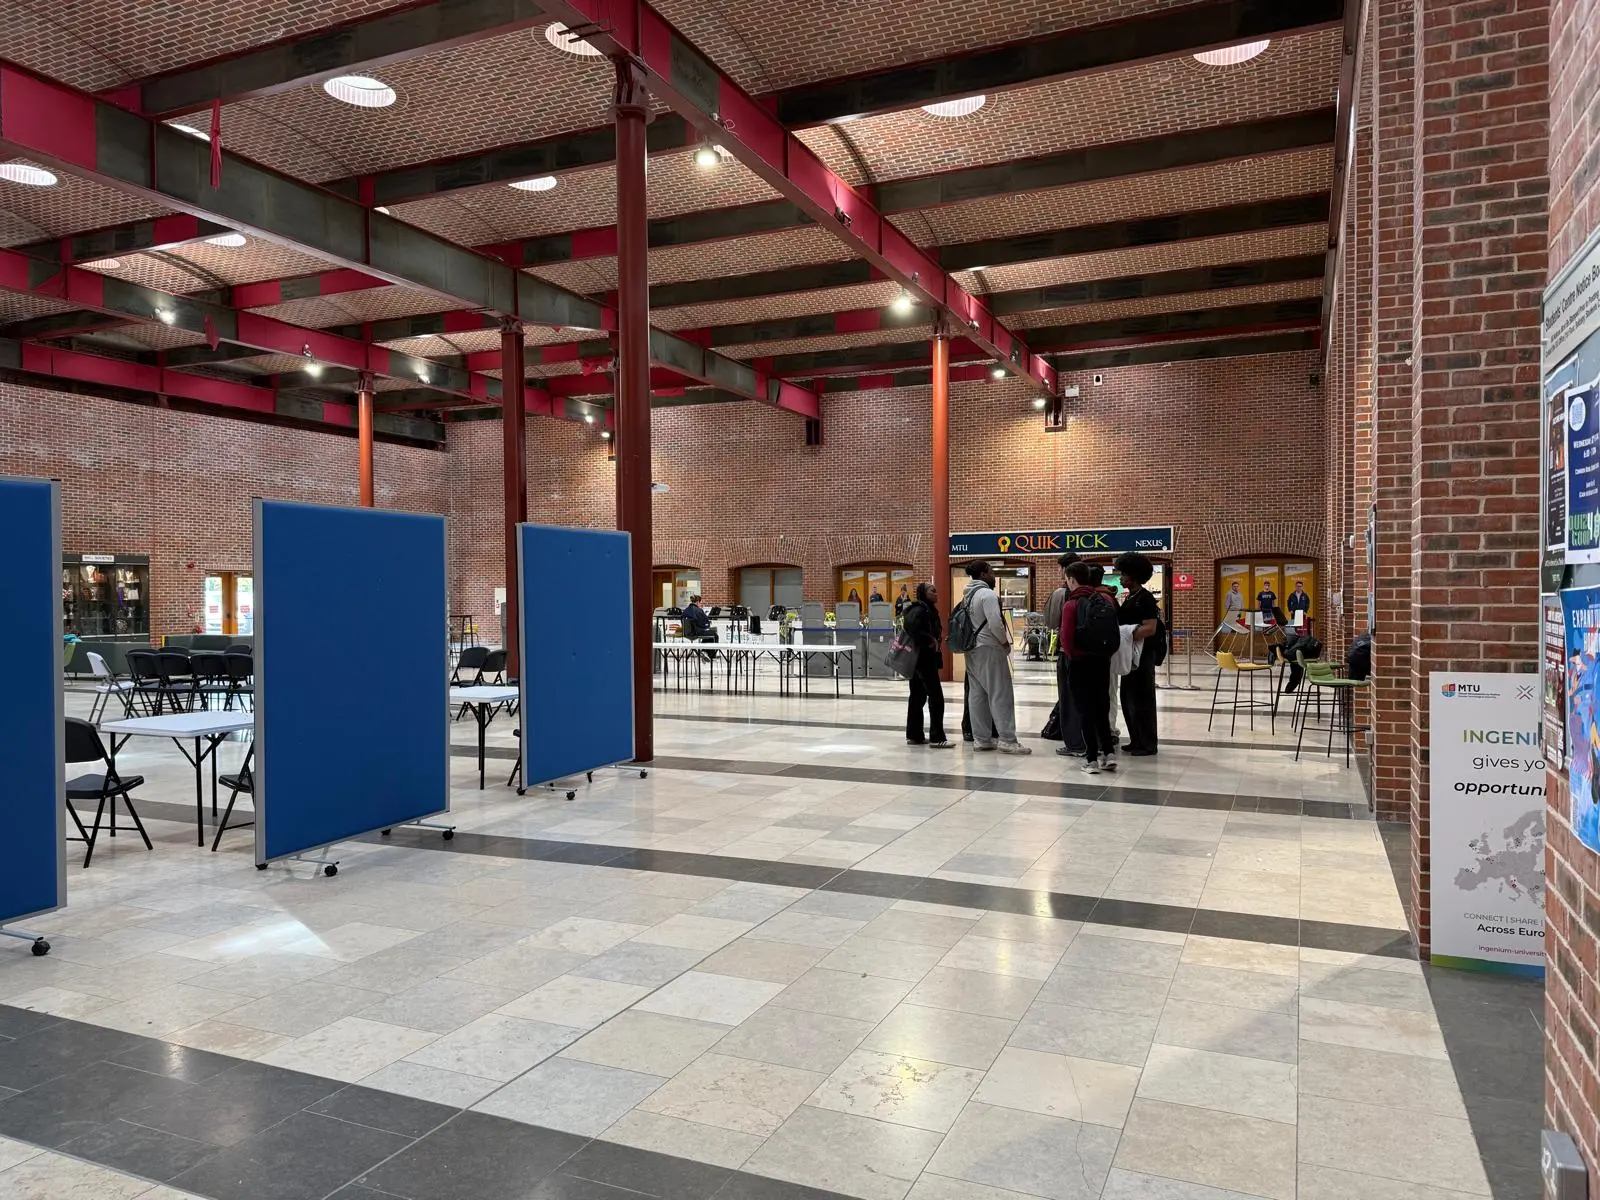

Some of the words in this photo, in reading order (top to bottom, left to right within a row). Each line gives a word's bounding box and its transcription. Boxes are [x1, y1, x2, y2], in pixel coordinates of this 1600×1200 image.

[1562, 290, 1575, 313] Centre
[1576, 273, 1591, 298] Notice
[951, 544, 968, 552] MTU
[1015, 534, 1061, 552] QUIK
[1065, 533, 1109, 549] PICK
[1135, 539, 1163, 548] NEXUS
[1458, 684, 1480, 692] MTU
[1472, 754, 1520, 770] gives
[1463, 912, 1504, 922] CONNECT
[1510, 917, 1539, 926] SHARE
[1477, 923, 1515, 935] Across
